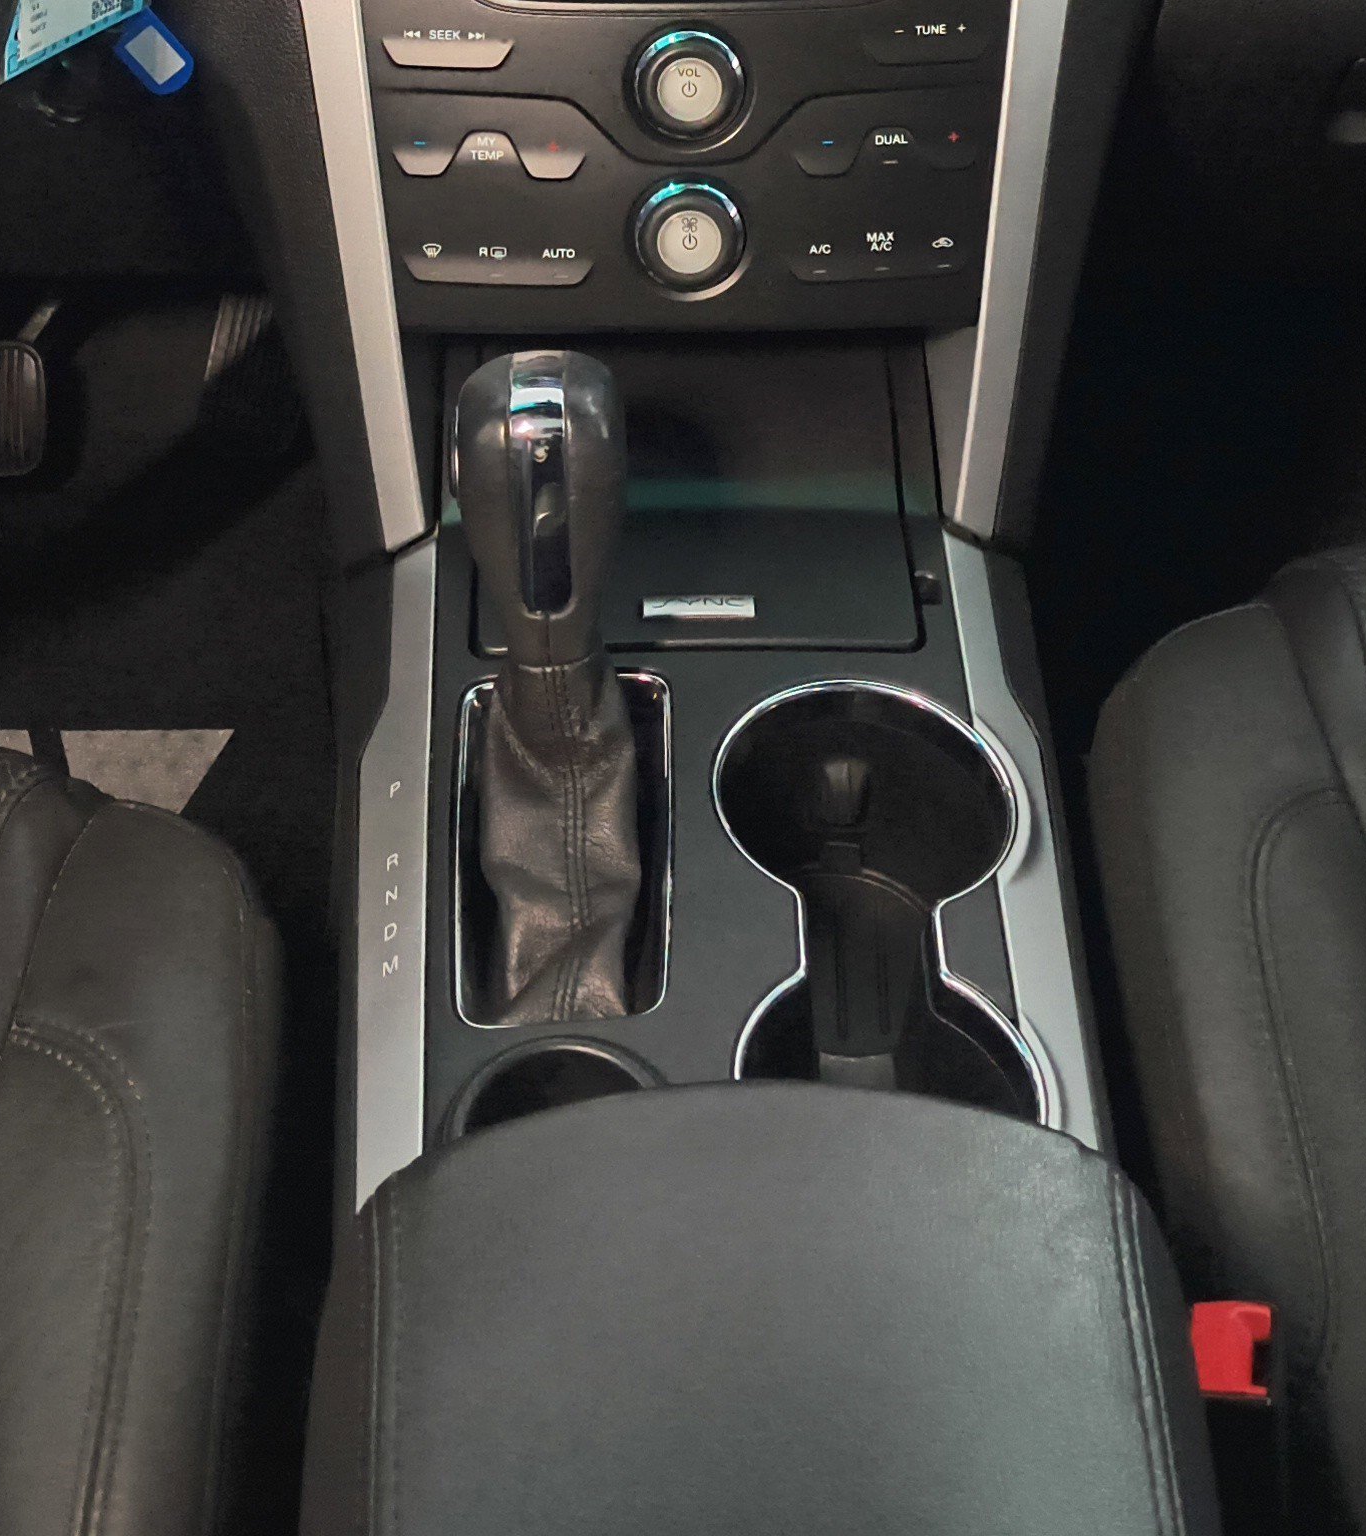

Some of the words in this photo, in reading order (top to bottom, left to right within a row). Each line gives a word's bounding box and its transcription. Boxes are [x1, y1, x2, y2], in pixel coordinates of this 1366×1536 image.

[428, 28, 462, 41] SEEK
[915, 23, 947, 36] TUNE
[677, 66, 701, 79] VOL
[476, 136, 497, 149] MY
[874, 133, 909, 146] DUAL
[470, 149, 505, 162] TEMP
[866, 231, 895, 244] MAX
[479, 246, 489, 259] R
[809, 243, 832, 256] A/C
[870, 240, 893, 253] A/C
[542, 247, 576, 260] AUTO
[389, 780, 401, 798] P
[386, 852, 399, 871] R
[386, 885, 398, 905] N
[384, 922, 398, 942] D
[382, 955, 399, 977] M
